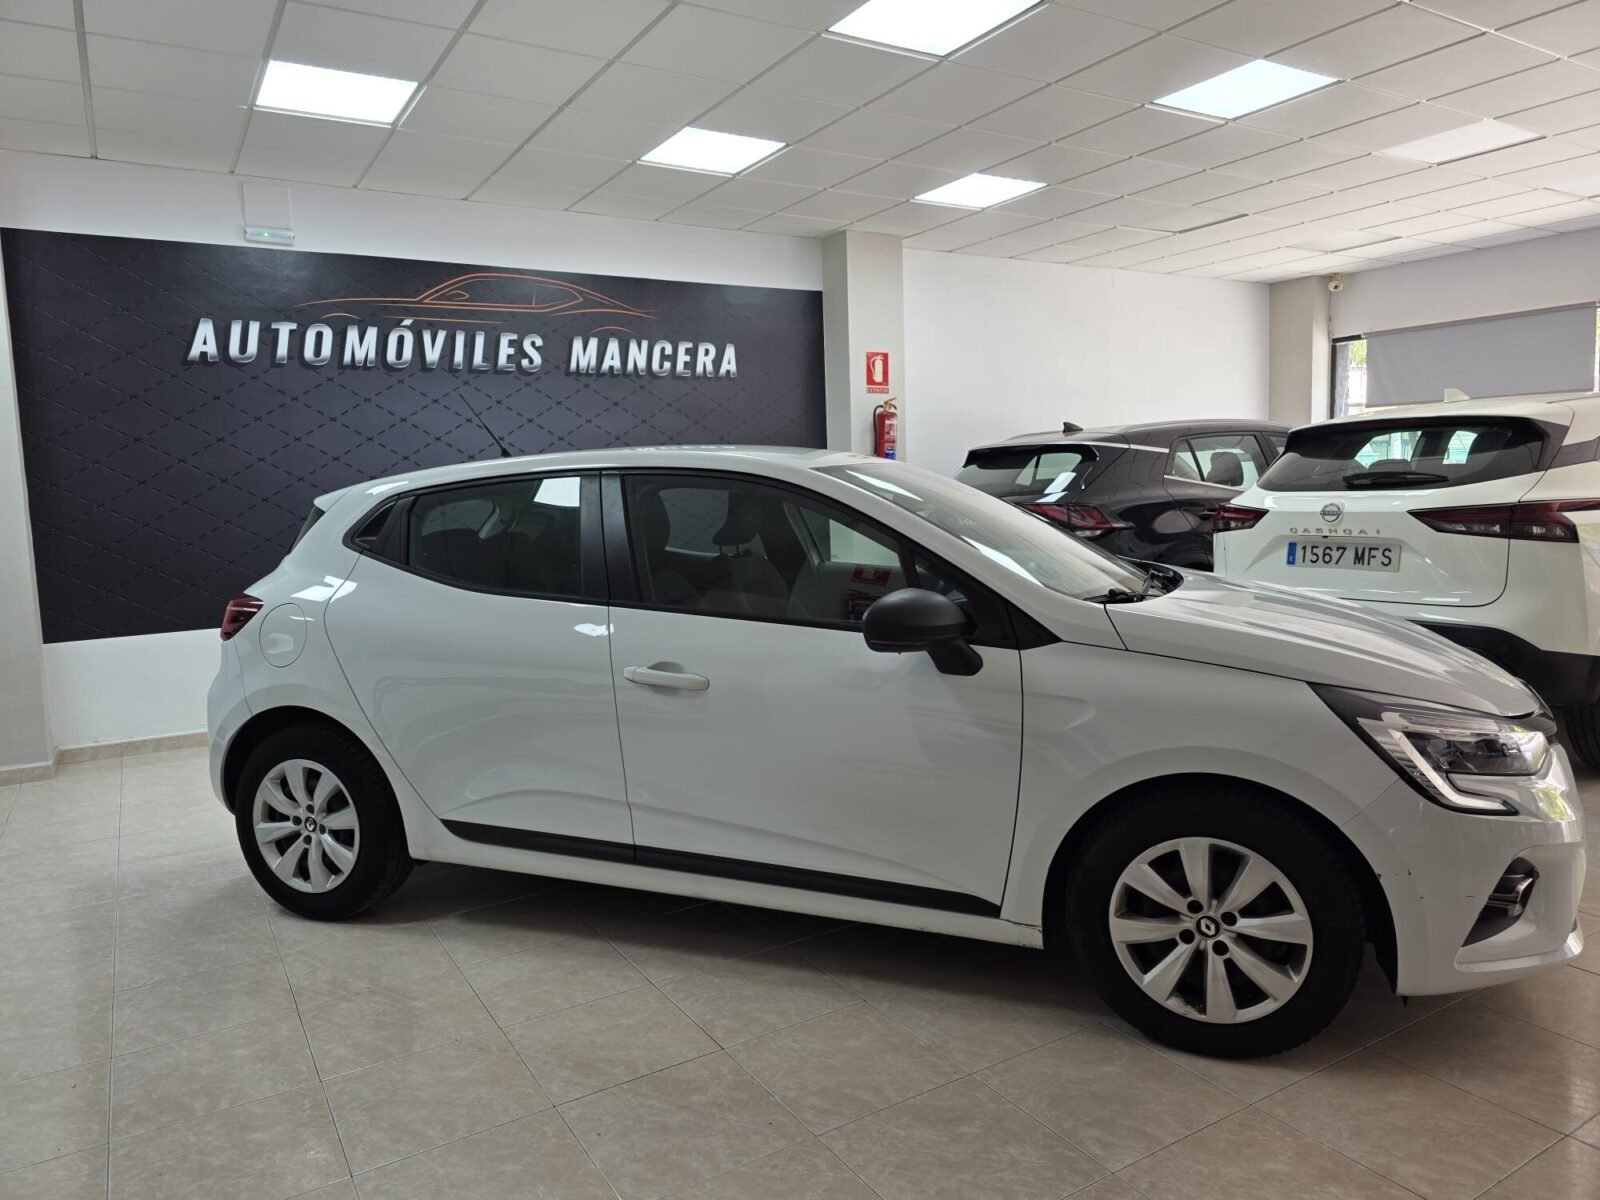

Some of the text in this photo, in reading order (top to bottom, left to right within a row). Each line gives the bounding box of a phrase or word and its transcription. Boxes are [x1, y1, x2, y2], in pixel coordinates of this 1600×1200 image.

[187, 317, 738, 378] AUTOMÓVILES MANCERA
[1290, 527, 1381, 536] QASHQAI
[1301, 545, 1347, 566] 1567
[1353, 546, 1393, 567] MFS
